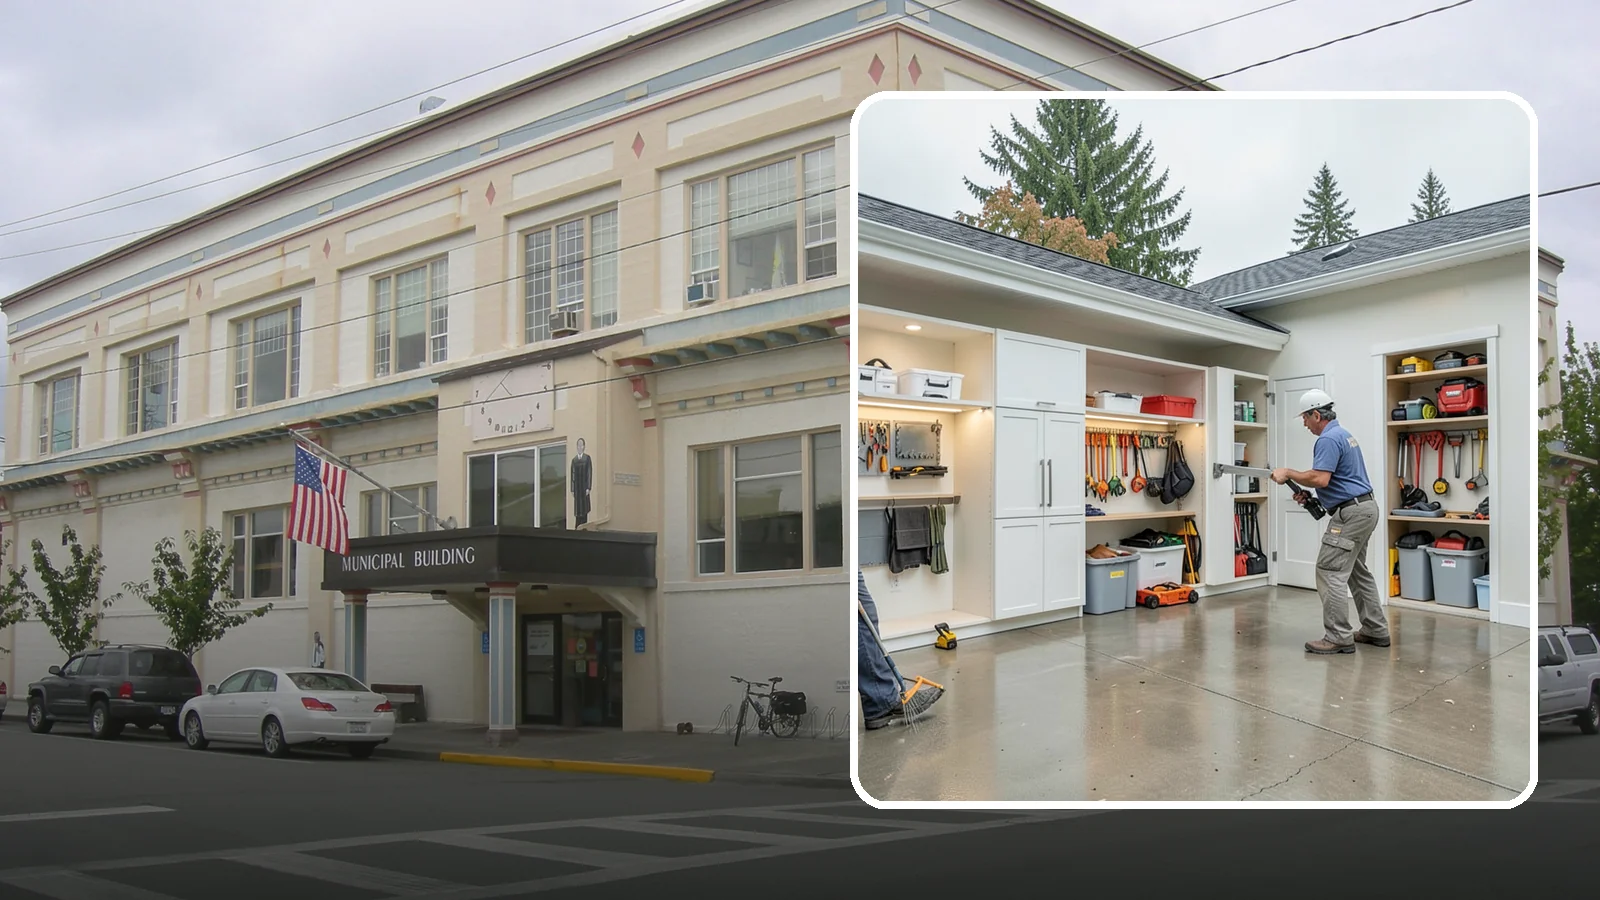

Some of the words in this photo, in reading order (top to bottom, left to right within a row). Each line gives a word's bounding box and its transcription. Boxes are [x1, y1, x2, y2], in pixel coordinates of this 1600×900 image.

[507, 425, 513, 433] 12
[342, 552, 405, 572] MUNICIPAL
[414, 546, 475, 567] BUILDING
